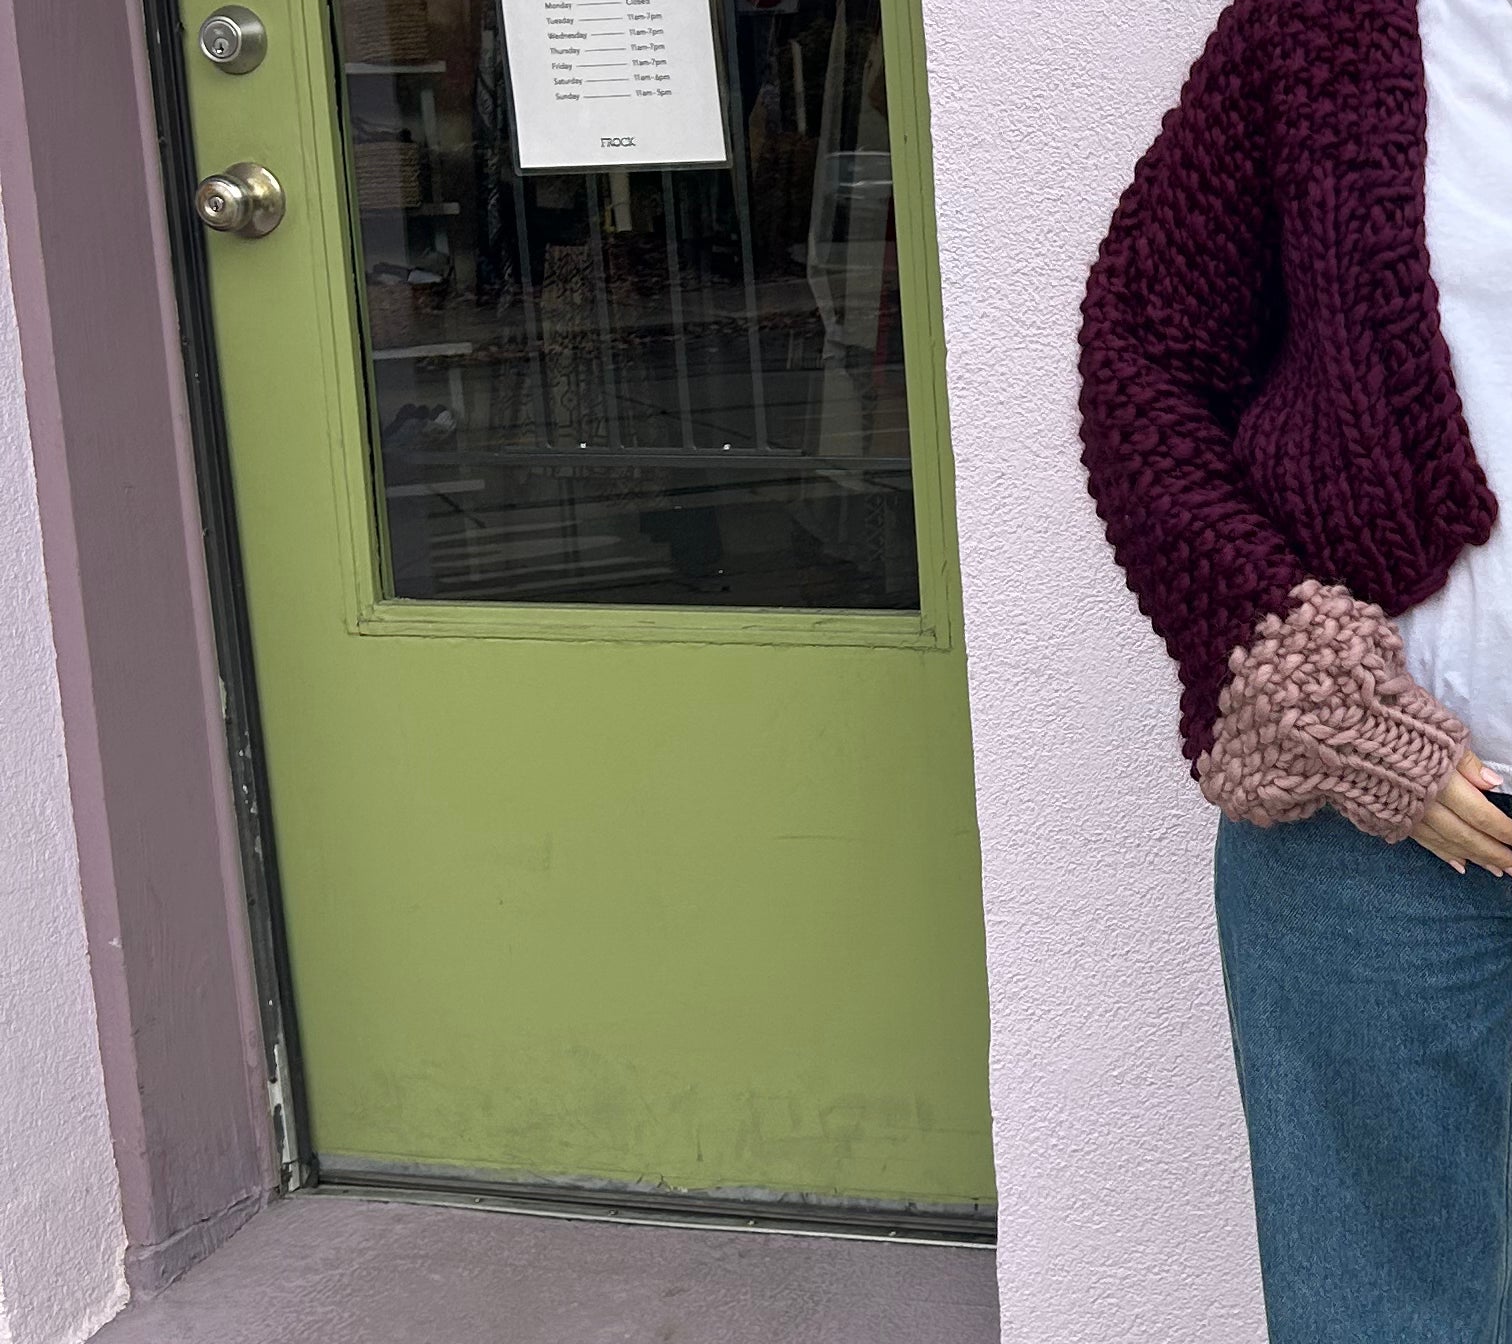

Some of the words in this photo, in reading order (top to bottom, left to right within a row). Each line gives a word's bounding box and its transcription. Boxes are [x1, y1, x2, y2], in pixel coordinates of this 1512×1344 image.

[544, 2, 572, 10] Monday
[546, 17, 574, 25] Tuesday
[547, 31, 588, 40] Wednesday
[550, 46, 581, 55] Thursday
[551, 62, 573, 71] Friday
[553, 77, 583, 86] Saturday
[555, 92, 580, 101] Sunday
[600, 136, 636, 147] FROCK
